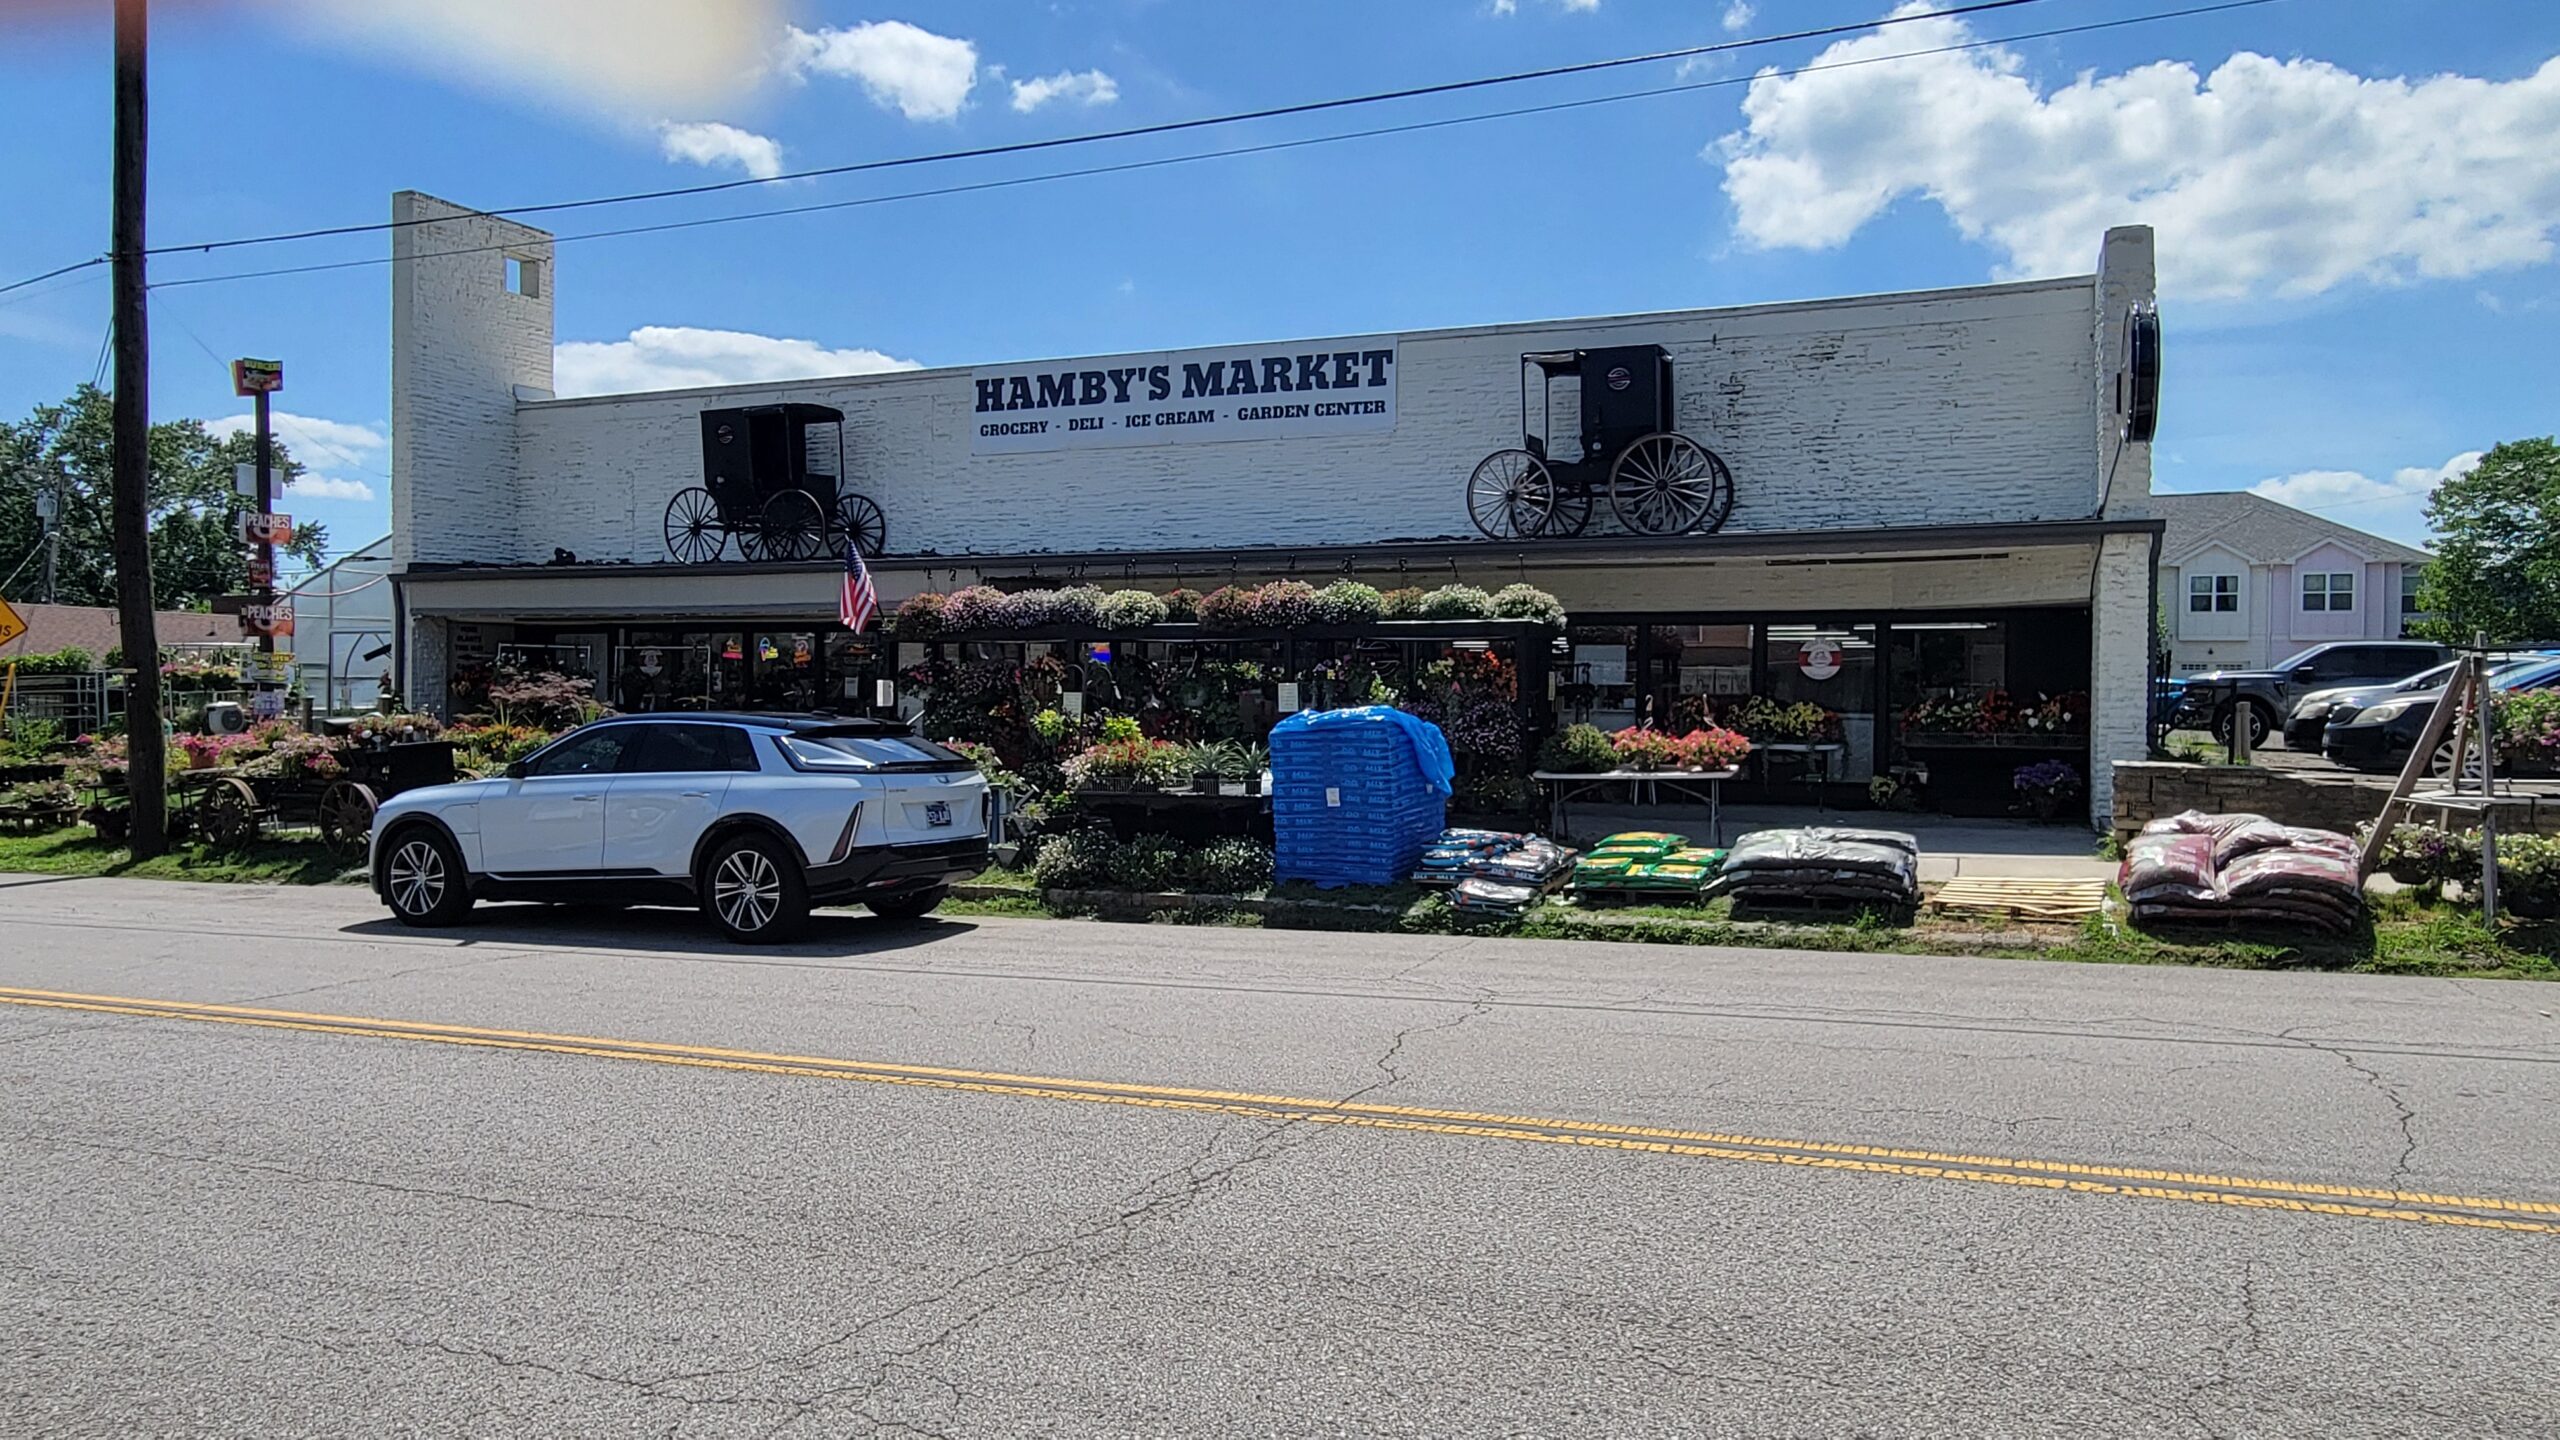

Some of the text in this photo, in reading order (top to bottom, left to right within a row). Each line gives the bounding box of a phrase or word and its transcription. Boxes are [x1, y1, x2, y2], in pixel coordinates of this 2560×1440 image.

[975, 349, 1393, 412] HAMBY'S MARKET
[979, 421, 1048, 437] GROCERY
[1068, 416, 1104, 431] DELI
[1125, 413, 1152, 428] ICE
[1154, 409, 1215, 426] CREAM
[1237, 403, 1310, 420] GARDEN
[1313, 400, 1387, 417] CENTER
[247, 513, 289, 528] PEACHES
[247, 605, 292, 620] PEACHES
